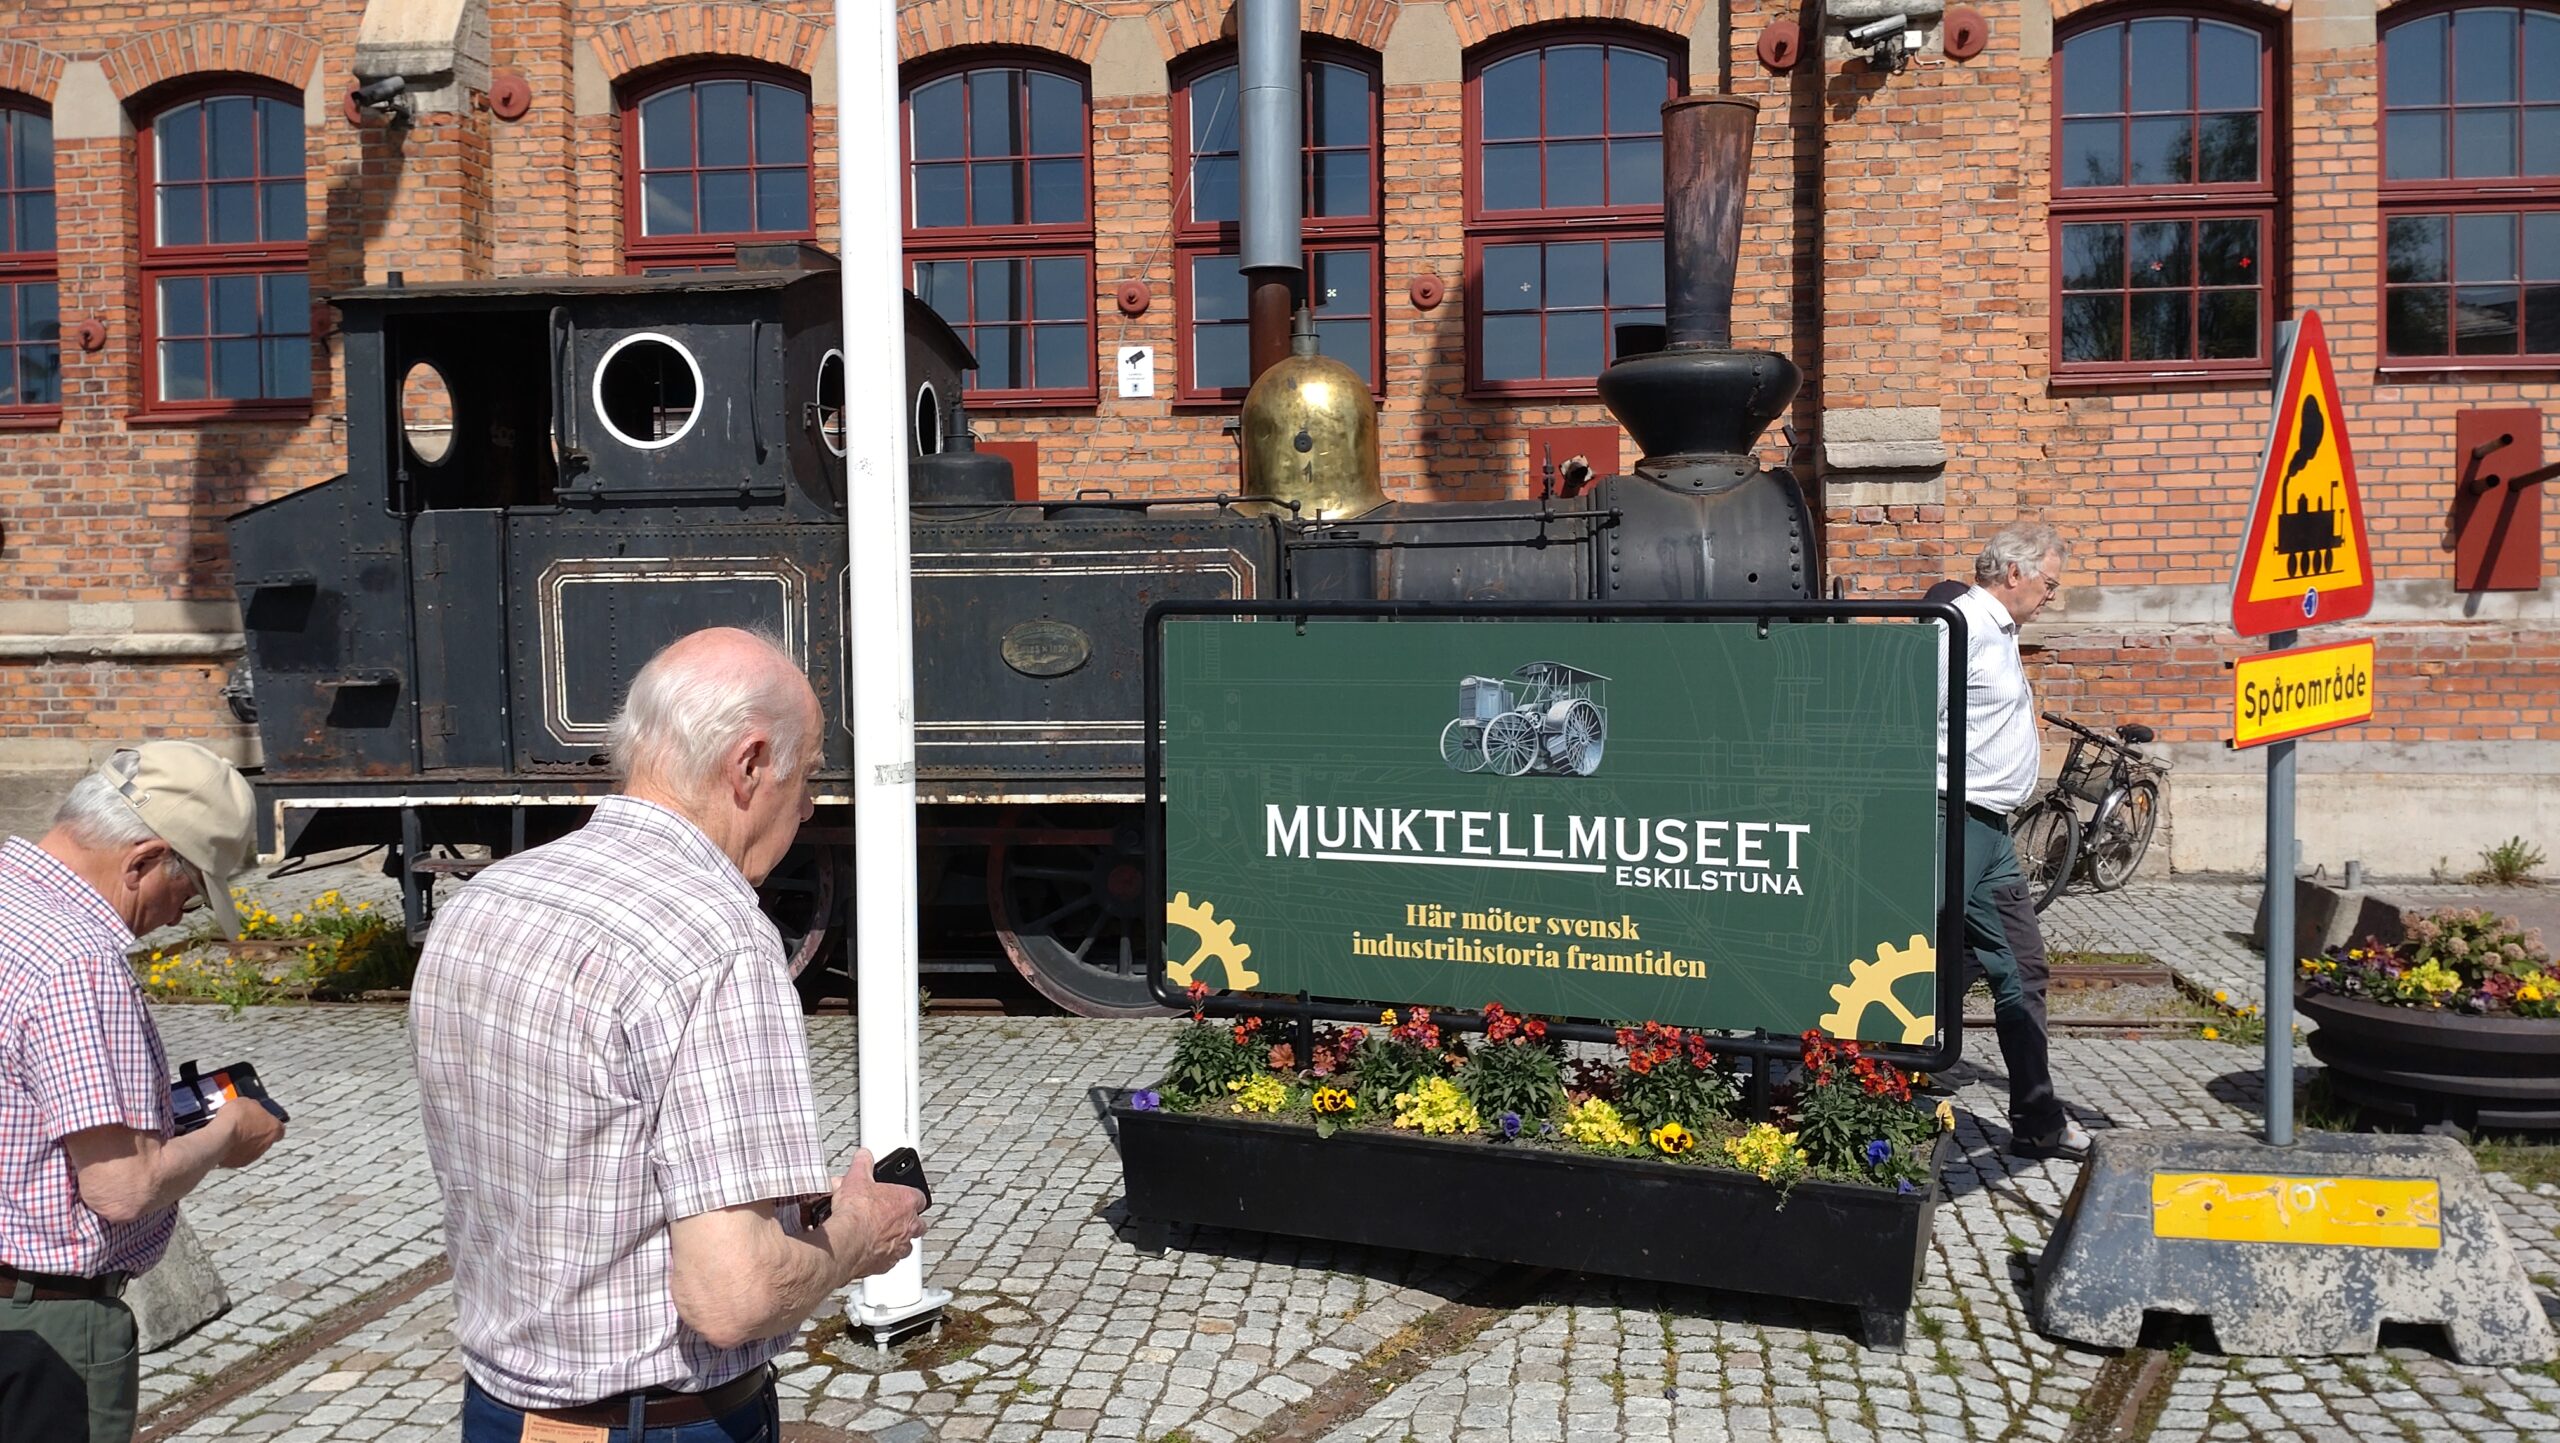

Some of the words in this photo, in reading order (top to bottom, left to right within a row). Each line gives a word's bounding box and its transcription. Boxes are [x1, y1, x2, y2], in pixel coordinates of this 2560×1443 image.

[2244, 664, 2366, 726] Spårområde
[1615, 865, 1805, 896] ESKILSTUNA
[1406, 903, 1456, 929] Här
[1461, 907, 1541, 934] möter
[1546, 912, 1640, 941] svensk
[1352, 930, 1561, 970] industrihistoria
[1566, 948, 1707, 979] framtiden
